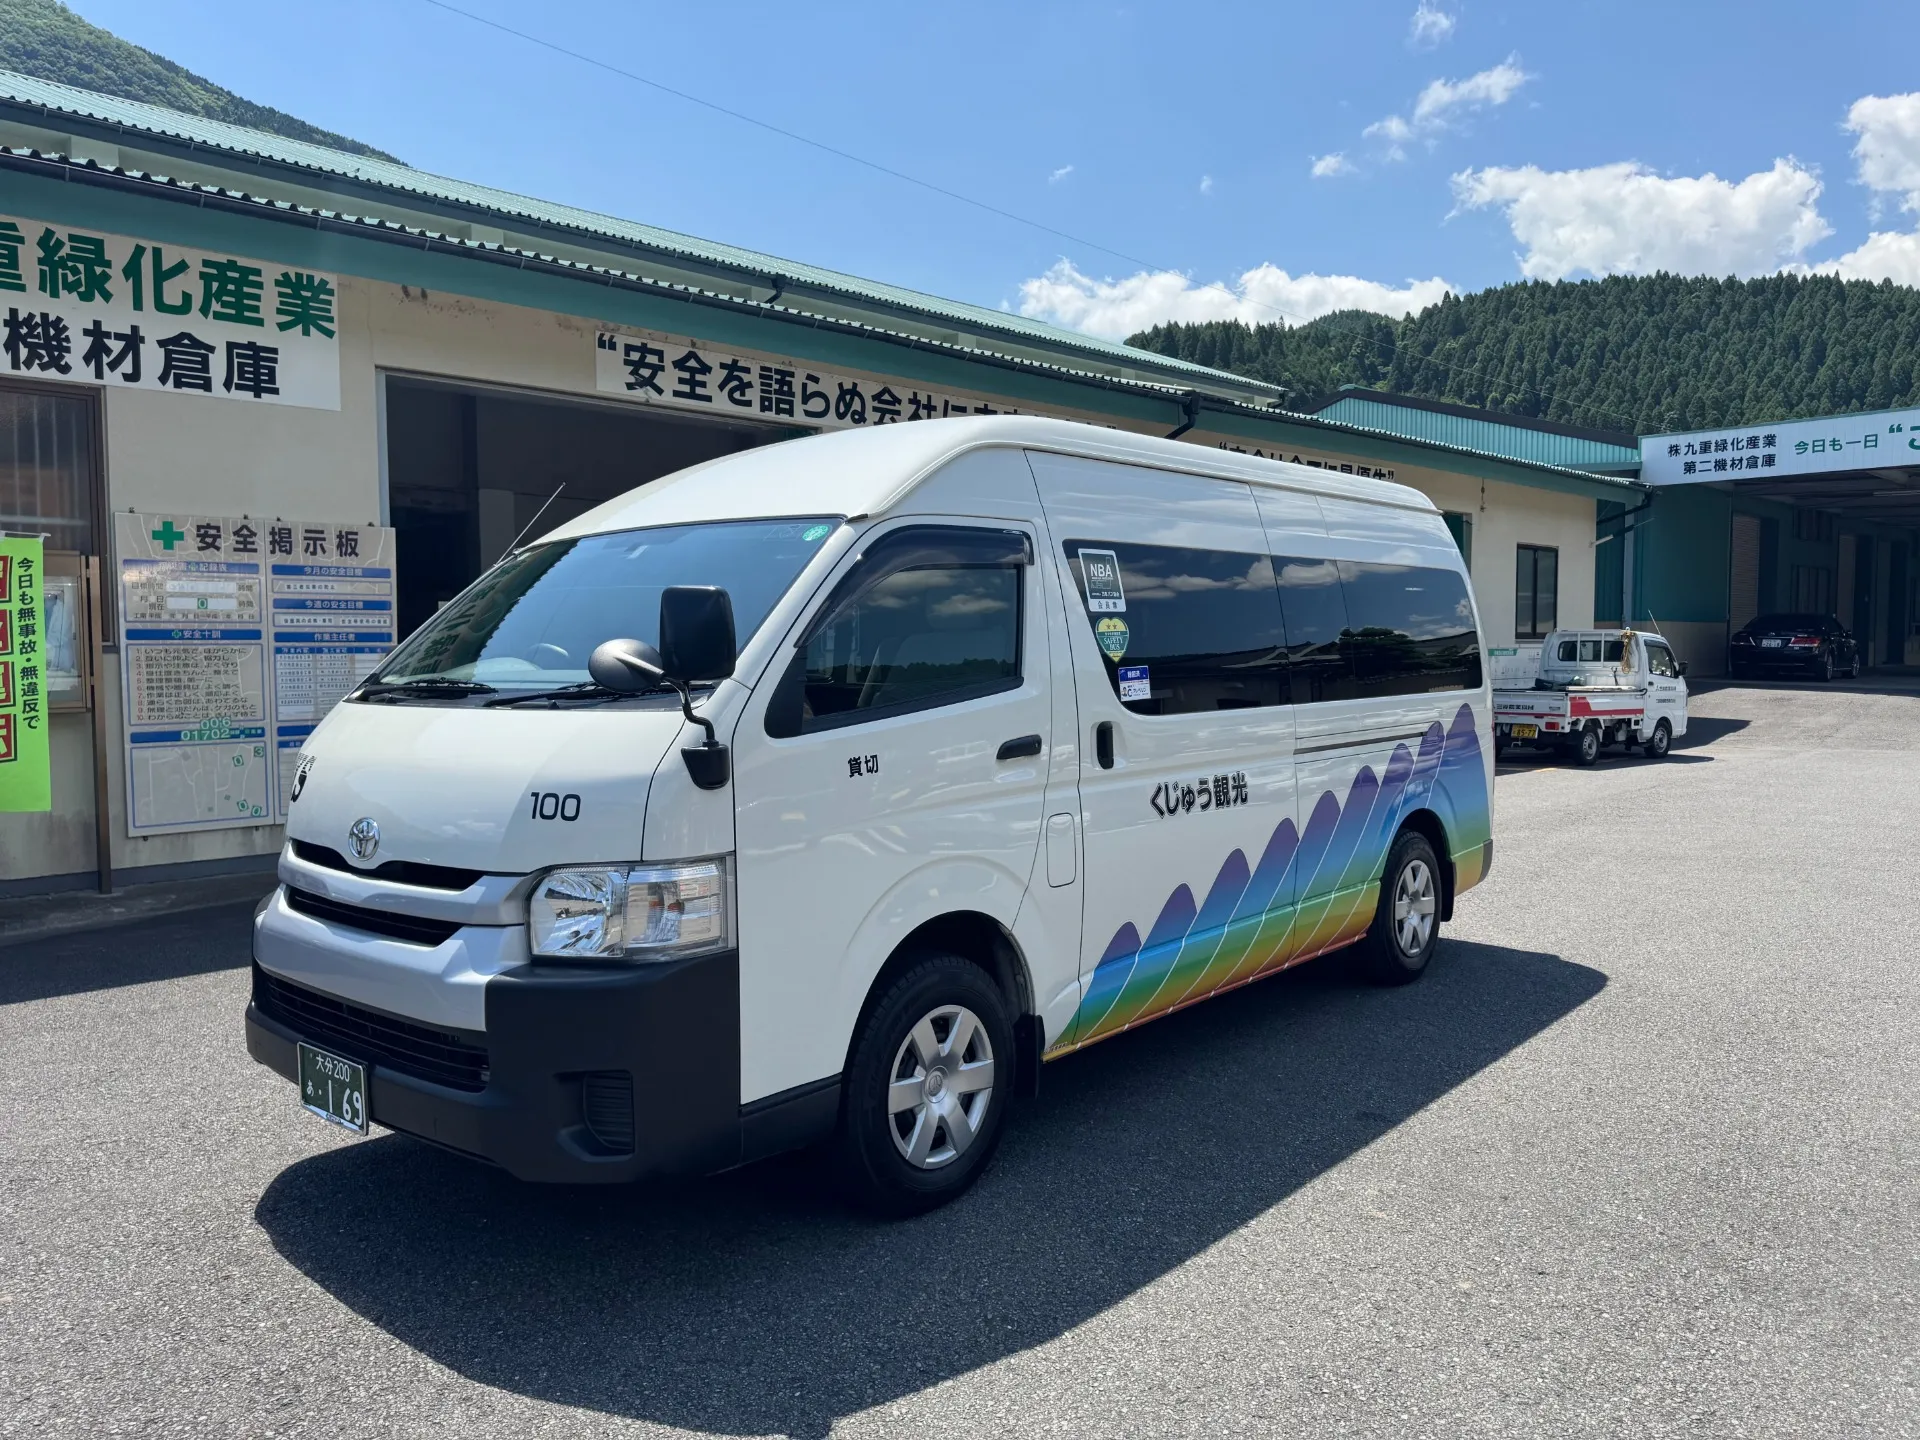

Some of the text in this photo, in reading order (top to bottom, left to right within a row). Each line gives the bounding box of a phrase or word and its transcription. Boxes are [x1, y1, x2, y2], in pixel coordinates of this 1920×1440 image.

[3, 307, 280, 398] 機材倉庫
[1794, 434, 1879, 456] 今日も一日
[1683, 453, 1776, 476] 第二機材倉庫
[196, 522, 360, 558] 安全掲示板
[303, 566, 363, 577] 今月の安全目標
[1090, 563, 1113, 577] NBA
[304, 600, 364, 610] 今週の安全目標
[17, 557, 41, 730] 今日も無事故・無違反で
[847, 753, 879, 778] 貸切
[530, 791, 582, 822] 100
[1149, 771, 1249, 820] くじゅう観光
[316, 1053, 350, 1083] 大分200
